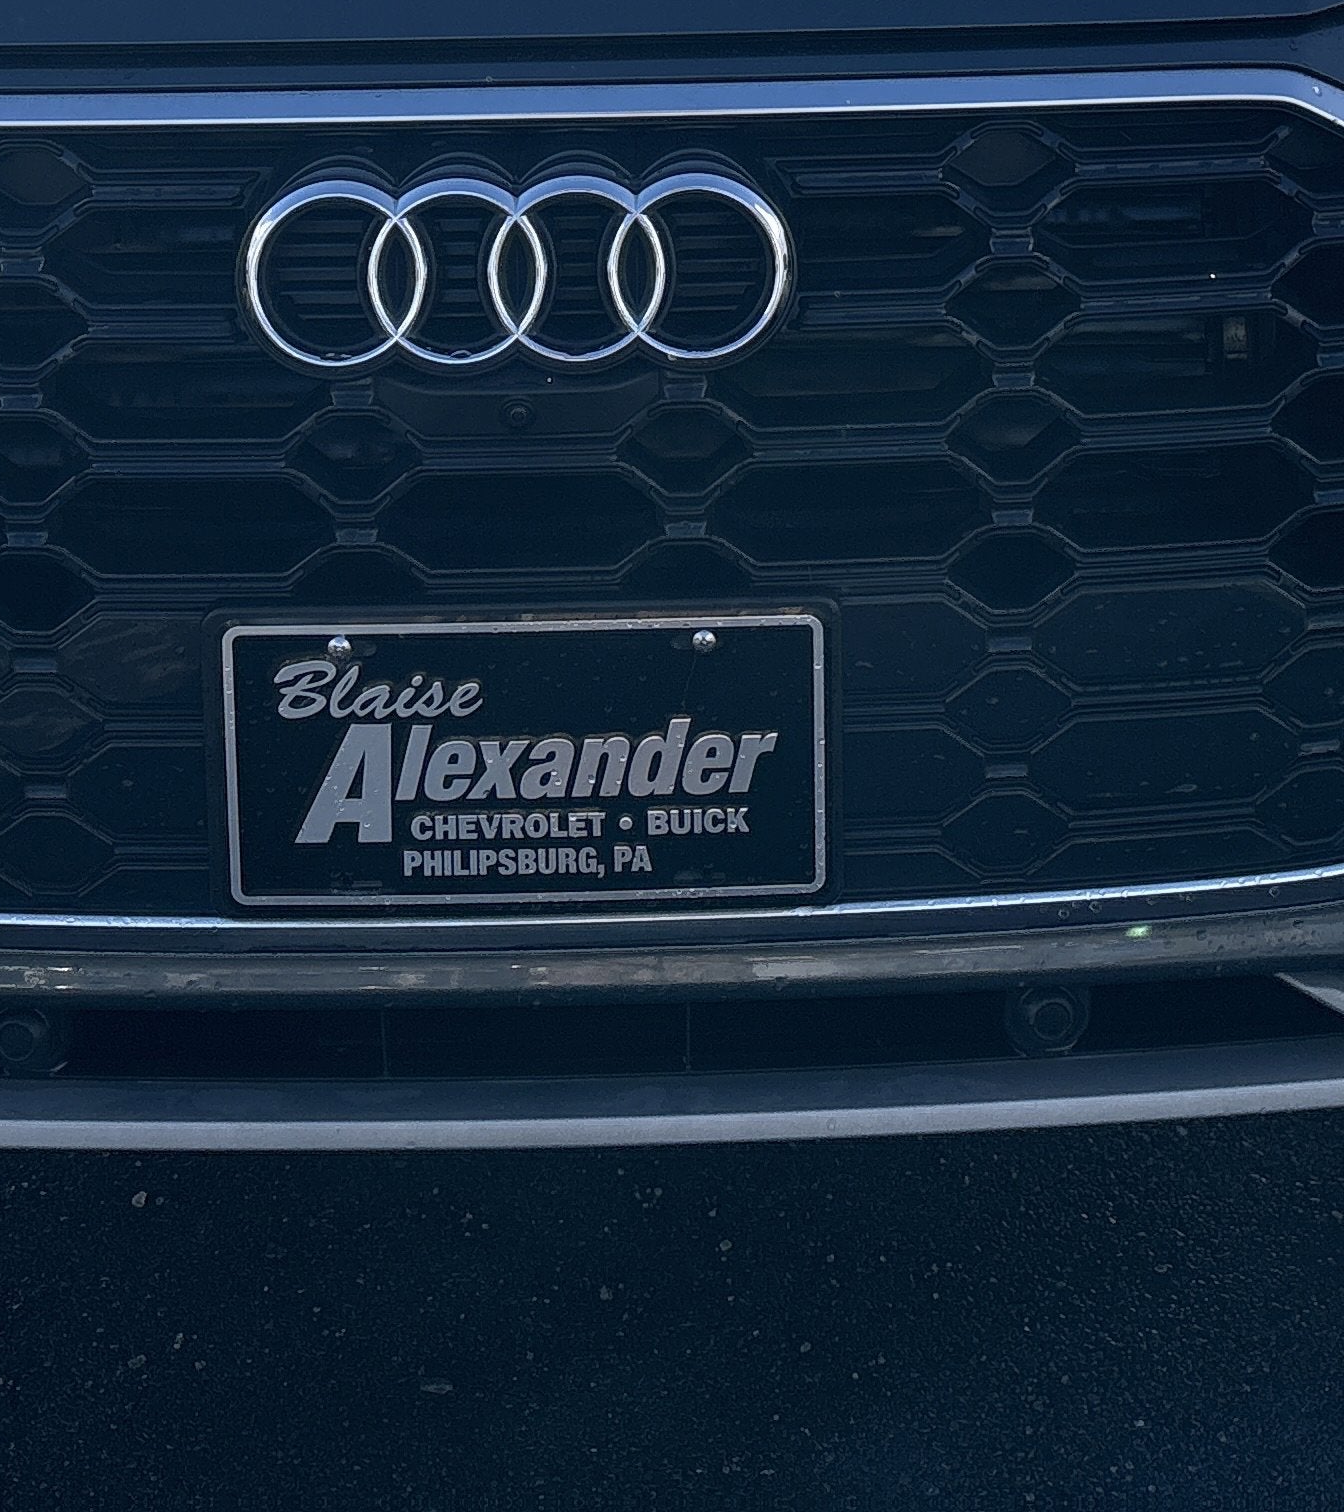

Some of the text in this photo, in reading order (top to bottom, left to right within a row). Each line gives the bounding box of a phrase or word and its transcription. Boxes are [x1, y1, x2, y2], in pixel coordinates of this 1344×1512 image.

[273, 659, 483, 720] Blaise
[294, 718, 778, 844] Alexander
[410, 807, 750, 842] CHEVROLET BUICK
[403, 846, 653, 880] PHILIPSBURG, PA
